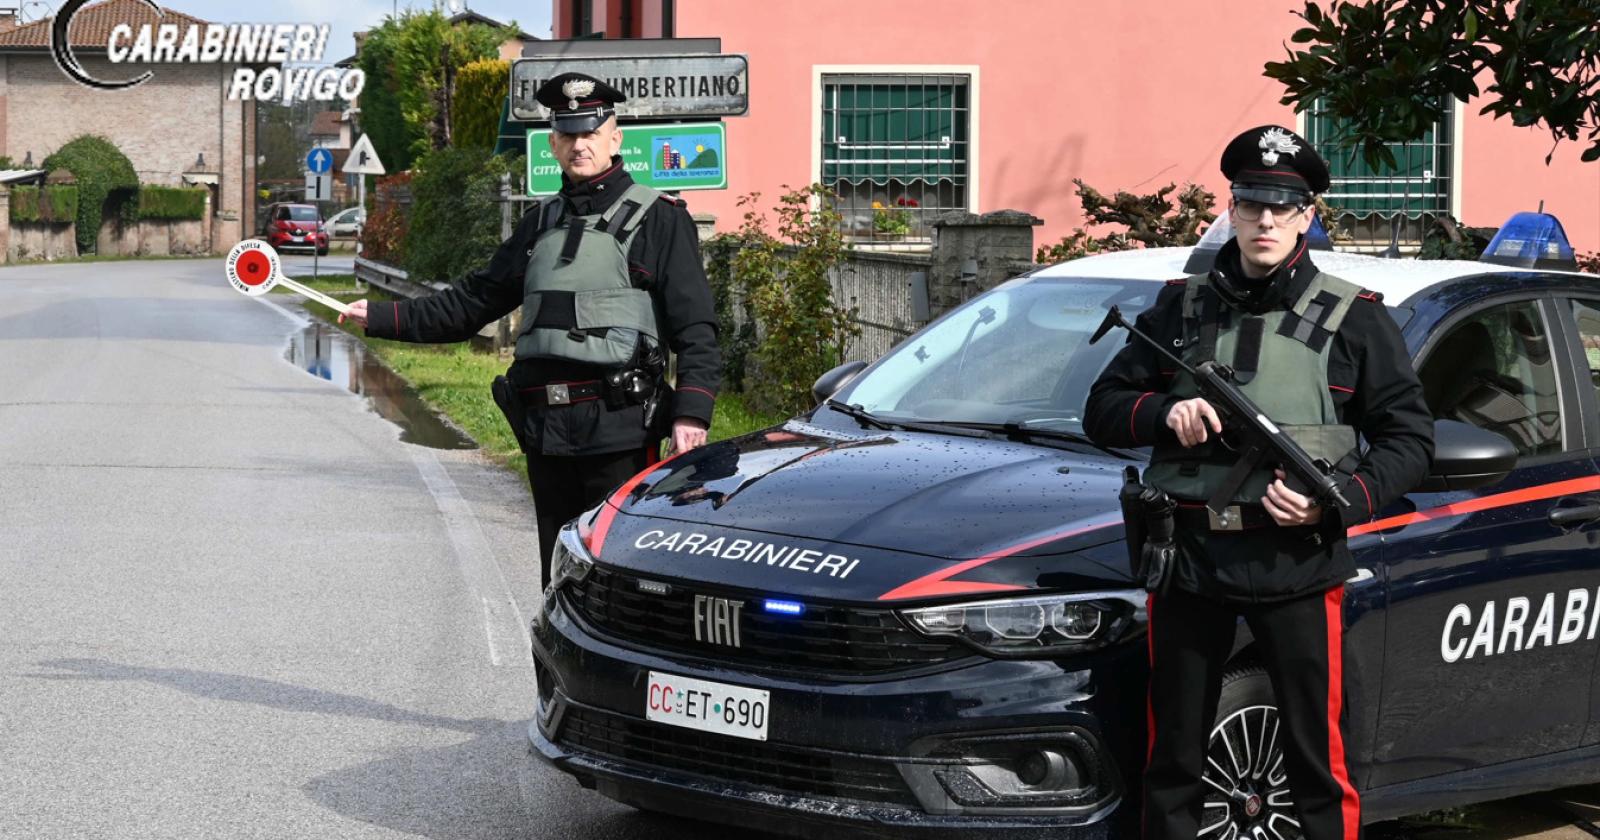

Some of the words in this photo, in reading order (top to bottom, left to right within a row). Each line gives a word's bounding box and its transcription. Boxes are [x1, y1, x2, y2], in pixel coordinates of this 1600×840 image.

[623, 162, 649, 172] ANZA
[229, 249, 241, 265] DELLA
[240, 242, 261, 251] DIFESA
[229, 267, 249, 292] MINISTERO
[634, 530, 860, 579] CARABINIERI
[694, 594, 745, 648] FIAT
[1441, 586, 1600, 663] CARABI
[649, 683, 673, 713] CC
[686, 689, 712, 720] ET
[723, 696, 765, 729] 690
